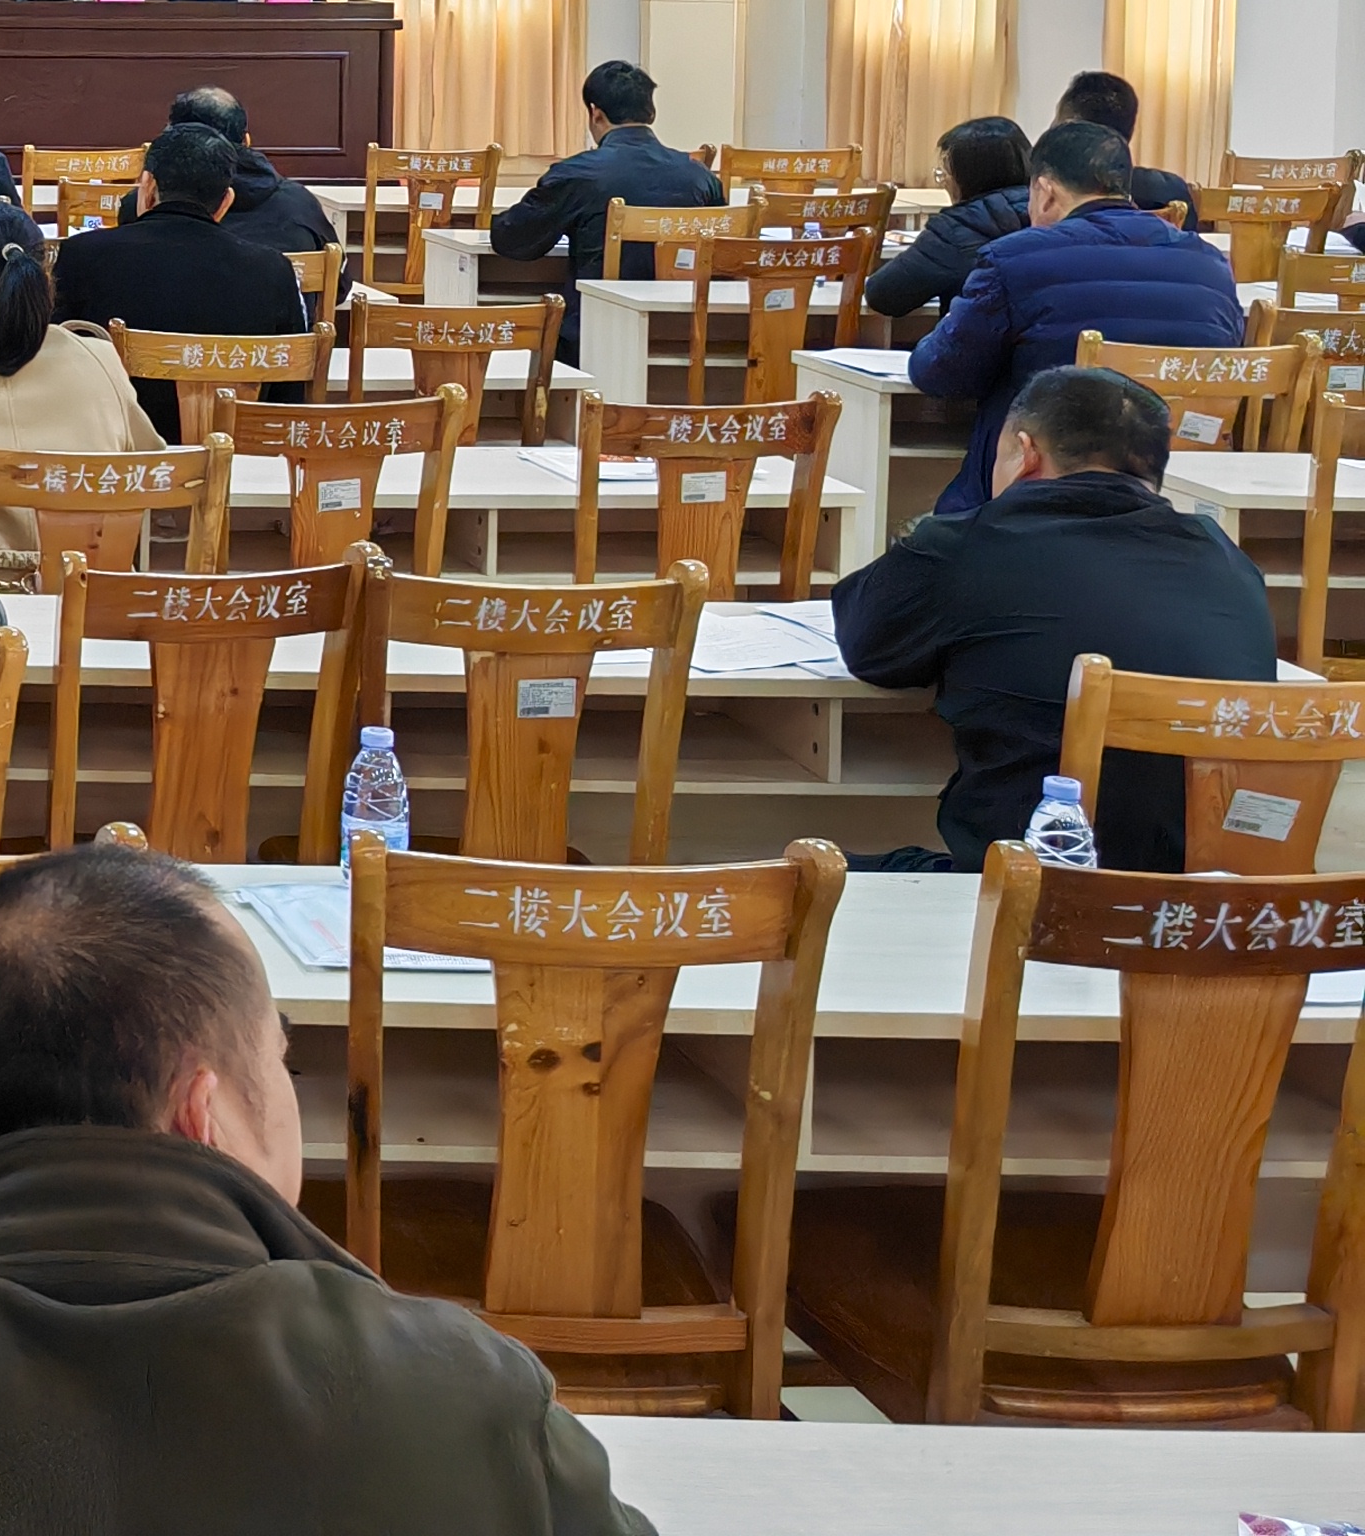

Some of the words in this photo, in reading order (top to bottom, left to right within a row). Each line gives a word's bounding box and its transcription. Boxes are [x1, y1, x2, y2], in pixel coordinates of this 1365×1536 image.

[54, 154, 132, 173] 二楼大会议室
[397, 154, 473, 174] 二楼大会议室
[1256, 162, 1339, 181] 二楼大会议室
[789, 199, 870, 219] 二楼大会议室
[744, 246, 843, 268] 二楼大会议室
[395, 320, 517, 348] 二楼大会议室
[161, 343, 292, 370] 二楼大会议室
[1136, 356, 1273, 385] 二楼大会议室
[261, 418, 407, 450] 二楼大会议室
[641, 414, 789, 446] 二楼大会议室
[17, 463, 176, 495] 二楼大会议室
[126, 579, 313, 623] 二楼大会议室
[438, 594, 638, 636] 二楼大会议室
[458, 885, 734, 941] 二楼大会议室
[1102, 897, 1365, 952] 二楼大会议室
